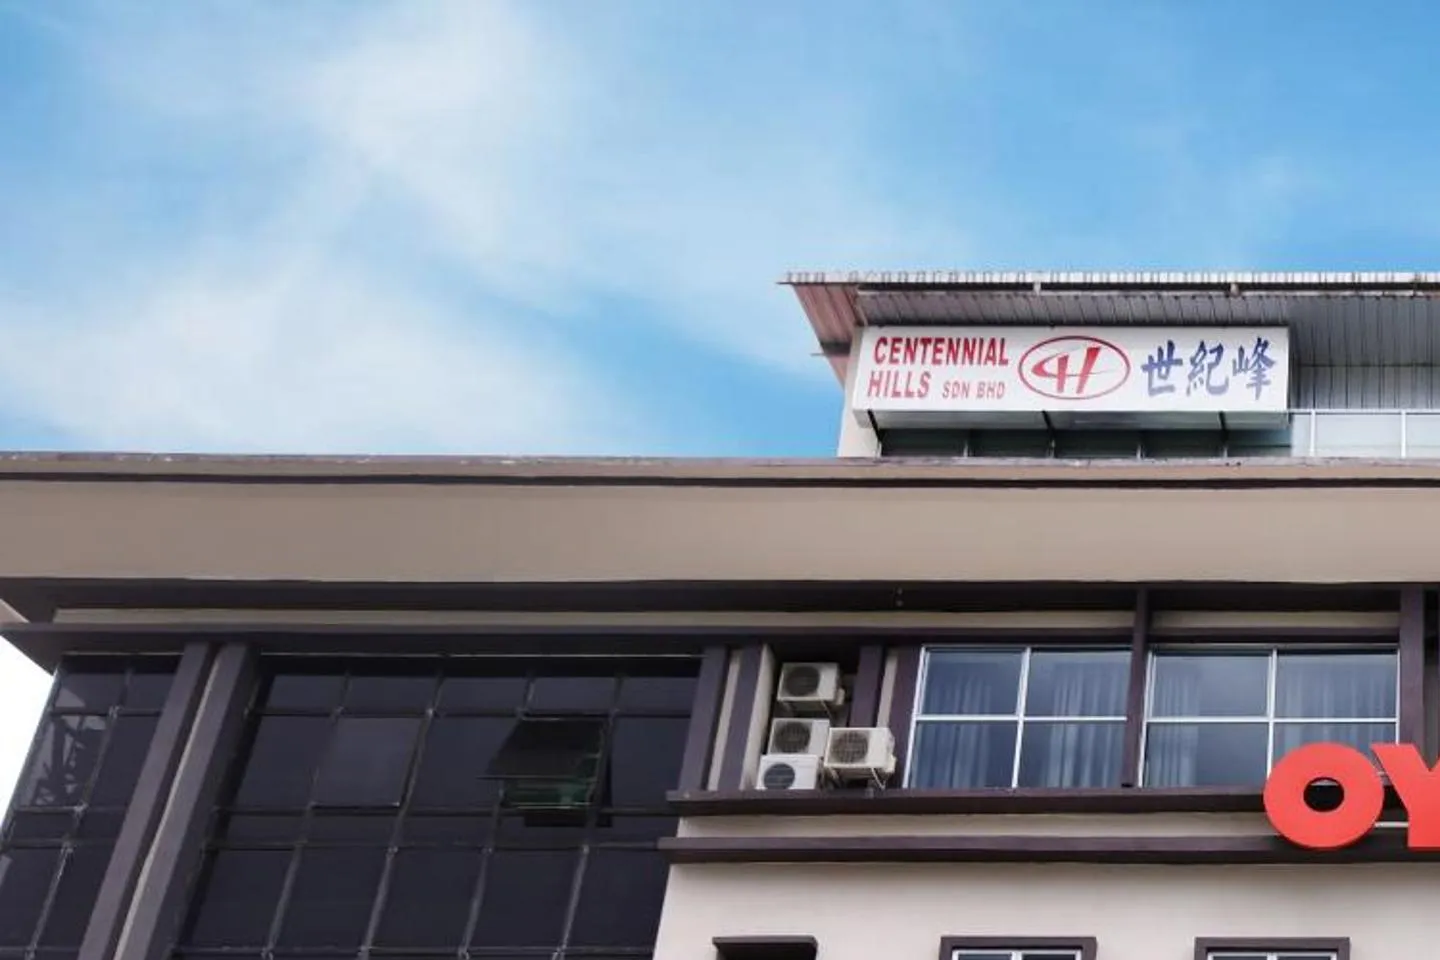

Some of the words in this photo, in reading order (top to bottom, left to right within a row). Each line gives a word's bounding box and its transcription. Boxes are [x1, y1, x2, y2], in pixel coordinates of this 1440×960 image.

[874, 336, 1009, 366] CENTENNIAL
[1140, 336, 1277, 401] 世紀峰
[867, 370, 931, 398] HILLS
[942, 380, 970, 399] SDN
[976, 380, 1006, 400] BHD
